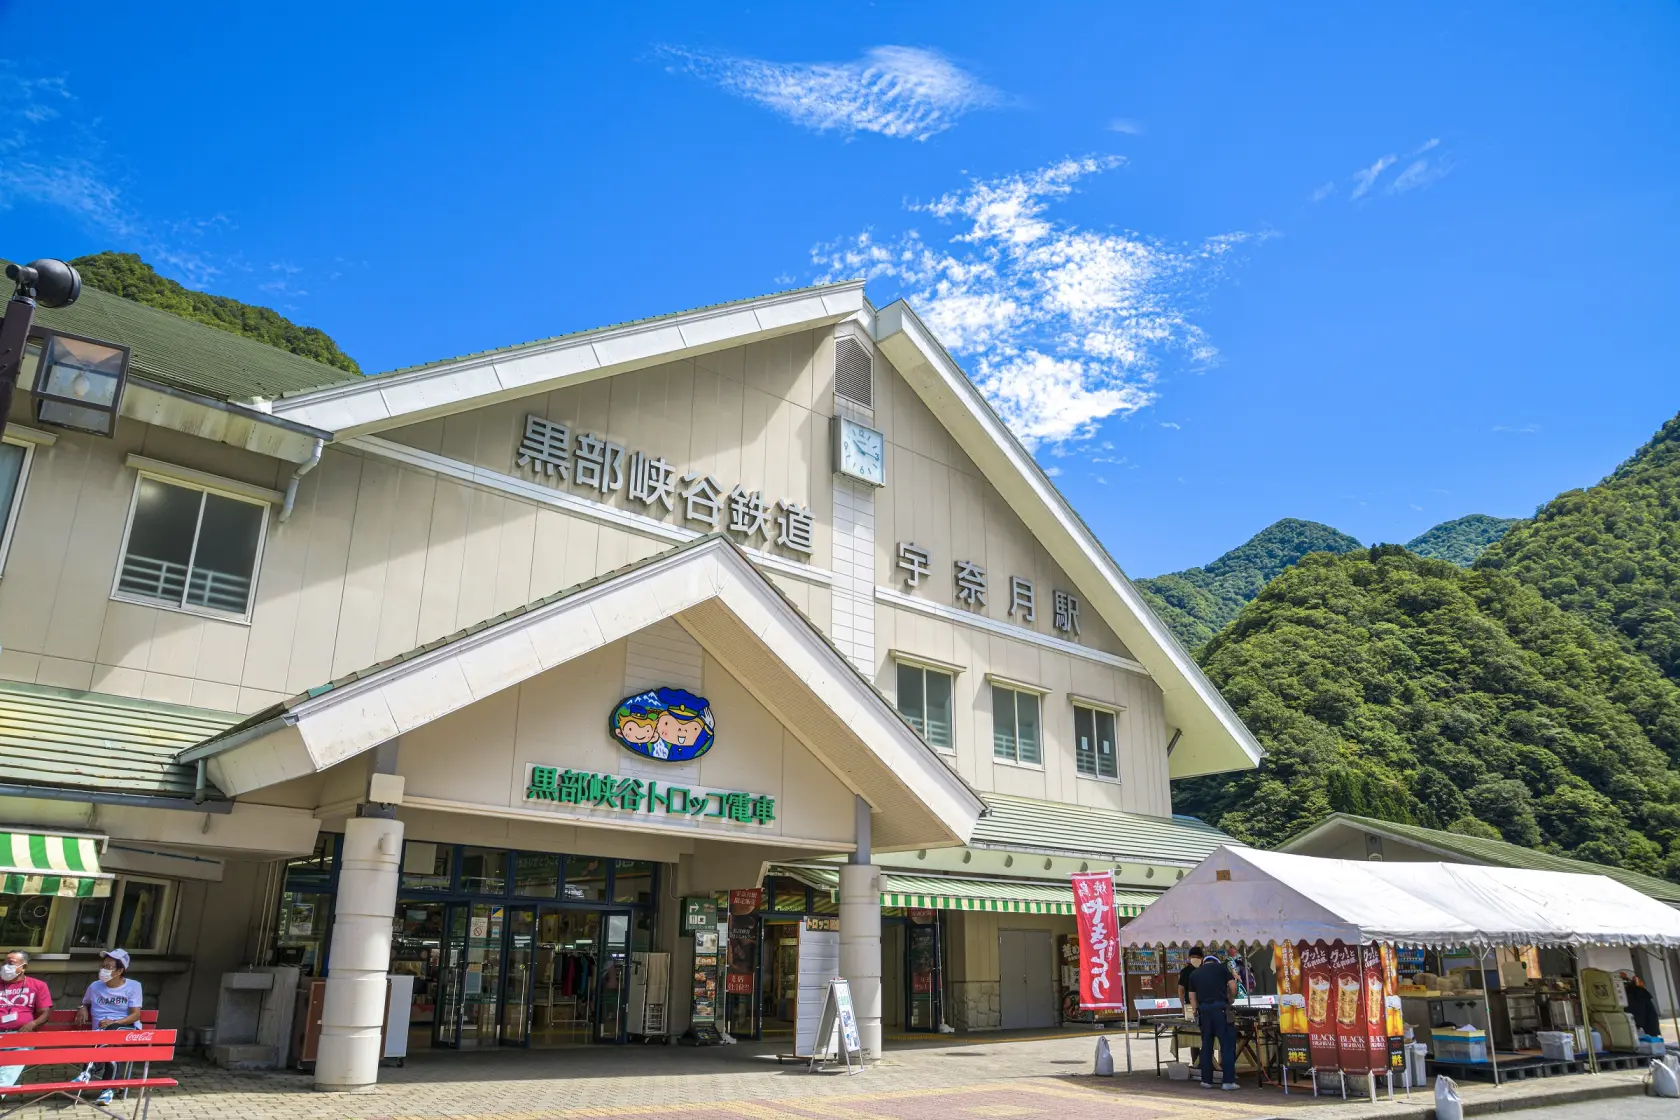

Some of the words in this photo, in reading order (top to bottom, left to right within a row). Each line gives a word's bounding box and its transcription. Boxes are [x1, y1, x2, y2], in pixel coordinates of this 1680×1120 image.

[516, 413, 816, 555] 黒部峡谷鉄道
[895, 541, 1081, 636] 宇奈月駅
[527, 765, 776, 825] 黒部峡谷トロッコ電車
[126, 1032, 154, 1042] Coca-Cola
[1311, 1033, 1336, 1042] BLACK
[1340, 1035, 1365, 1043] BLACK
[1288, 1051, 1308, 1063] 樽生
